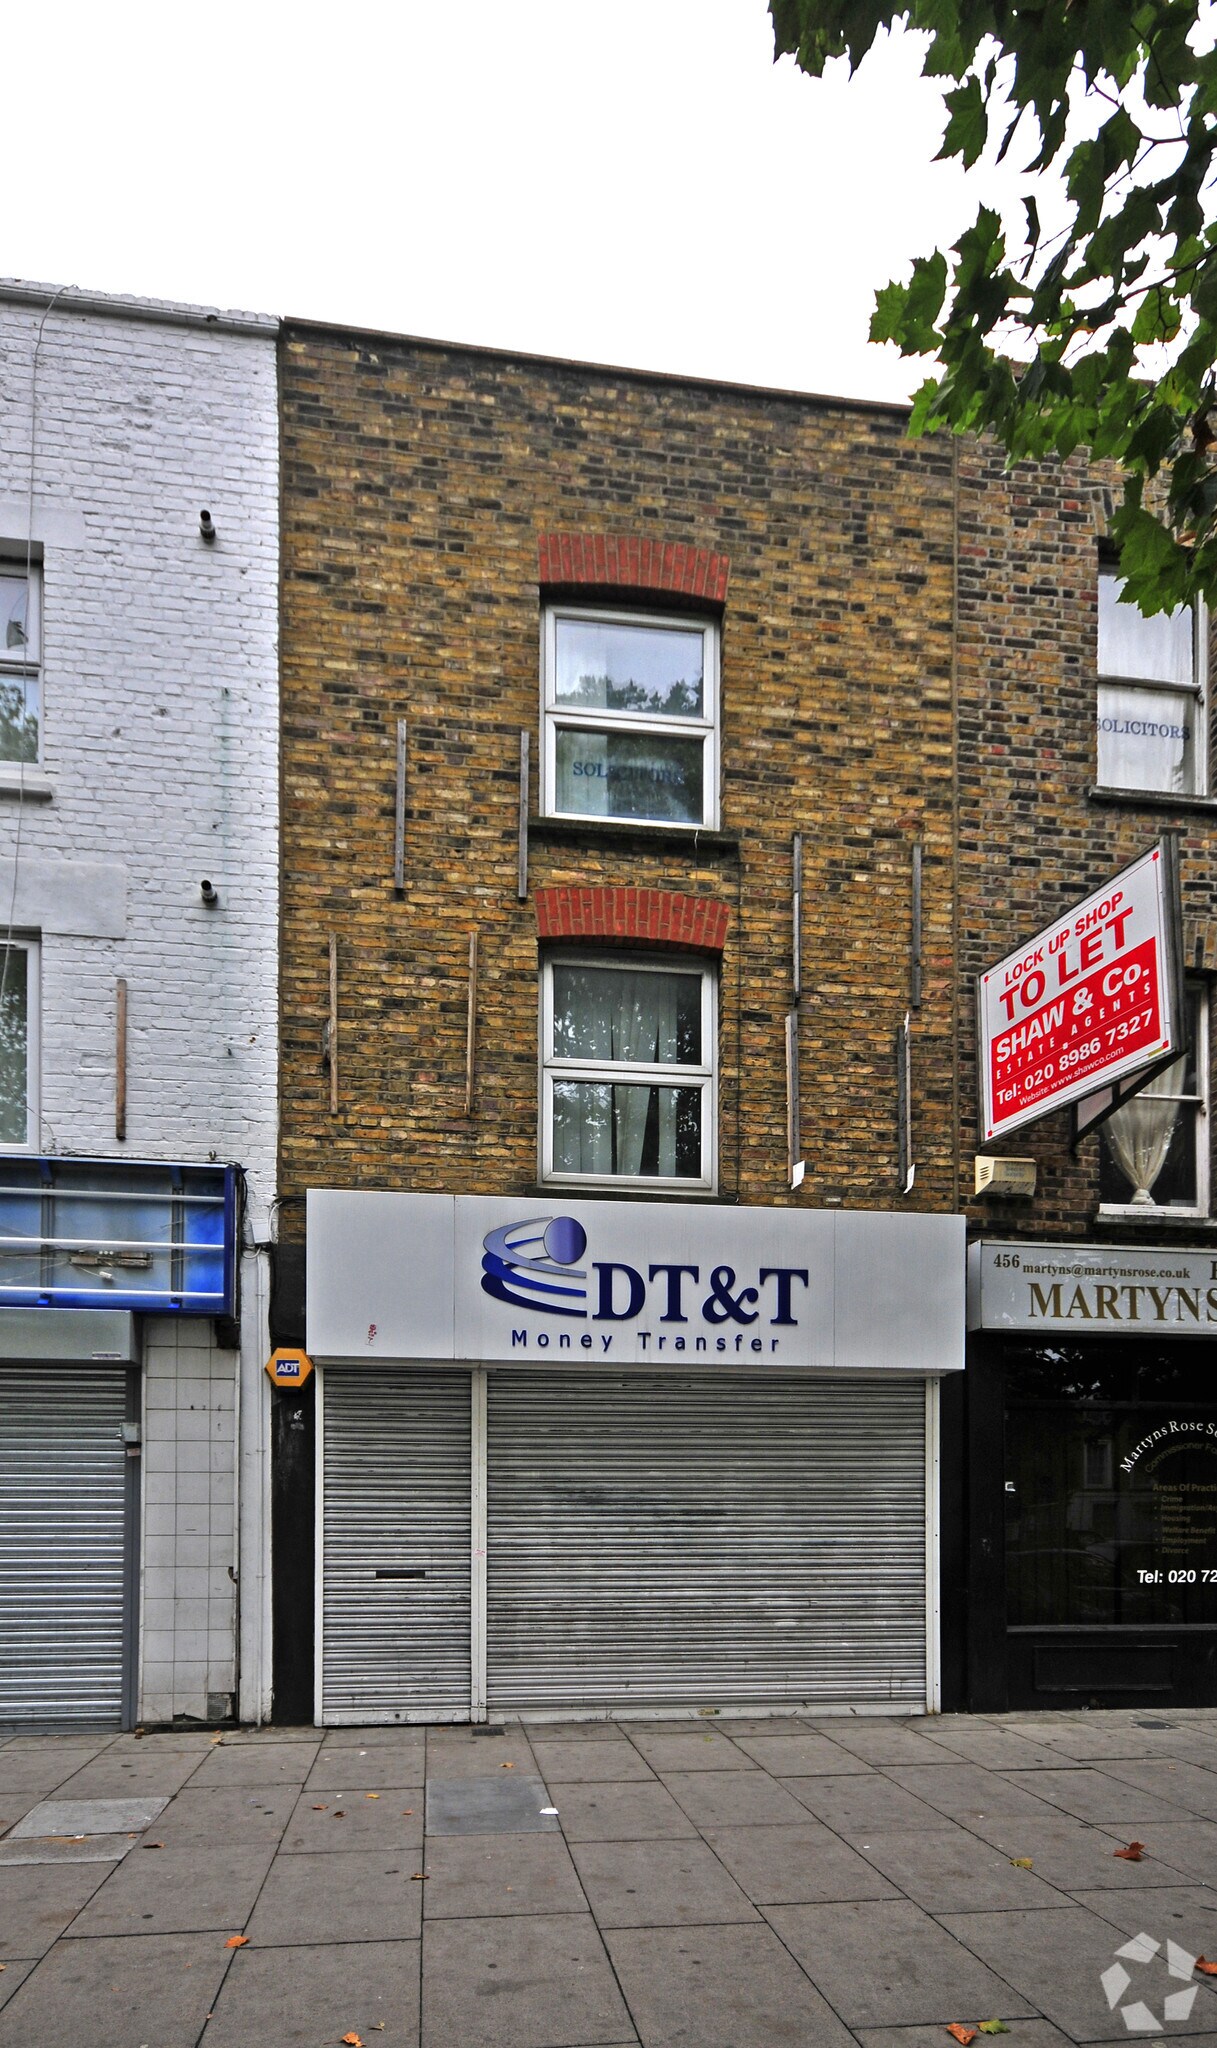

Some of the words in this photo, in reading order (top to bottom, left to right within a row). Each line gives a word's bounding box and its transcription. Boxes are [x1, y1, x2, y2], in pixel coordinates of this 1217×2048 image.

[1004, 946, 1045, 987] LOCK
[1047, 928, 1070, 956] UP
[1074, 890, 1124, 938] SHOP
[999, 969, 1046, 1022] TO
[1057, 905, 1134, 986] LET
[996, 1000, 1066, 1064] SHAW
[1073, 986, 1094, 1017] &
[1102, 963, 1150, 1000] Co.
[996, 1036, 1056, 1080] ESTATE
[1071, 981, 1151, 1037] AGENTS
[996, 1081, 1022, 1106] Tel:
[1024, 1063, 1055, 1092] 020
[1059, 1037, 1102, 1072] 8986
[1105, 1008, 1154, 1046] 7327
[1018, 1085, 1051, 1107] Website:
[1050, 1045, 1125, 1090] www.shawco.com
[993, 1254, 1020, 1269] 456
[1022, 1263, 1191, 1279] martyns@martynsrose.co.uk
[592, 1262, 809, 1325] DT&T
[1027, 1282, 1217, 1323] MARTYNS
[512, 1329, 614, 1353] Money
[638, 1332, 780, 1353] Transfer
[277, 1362, 300, 1374] ADT
[1120, 1426, 1168, 1473] Martyns
[1168, 1420, 1204, 1433] Rose
[1152, 1483, 1177, 1492] Areas
[1179, 1483, 1190, 1492] Of
[1161, 1495, 1183, 1503] Crime
[1161, 1514, 1191, 1524] Housing
[1162, 1526, 1189, 1535] Welfare
[1162, 1536, 1207, 1546] Employment
[1162, 1546, 1189, 1554] Divorce
[1137, 1569, 1163, 1583] Tel:
[1168, 1569, 1196, 1583] 020
